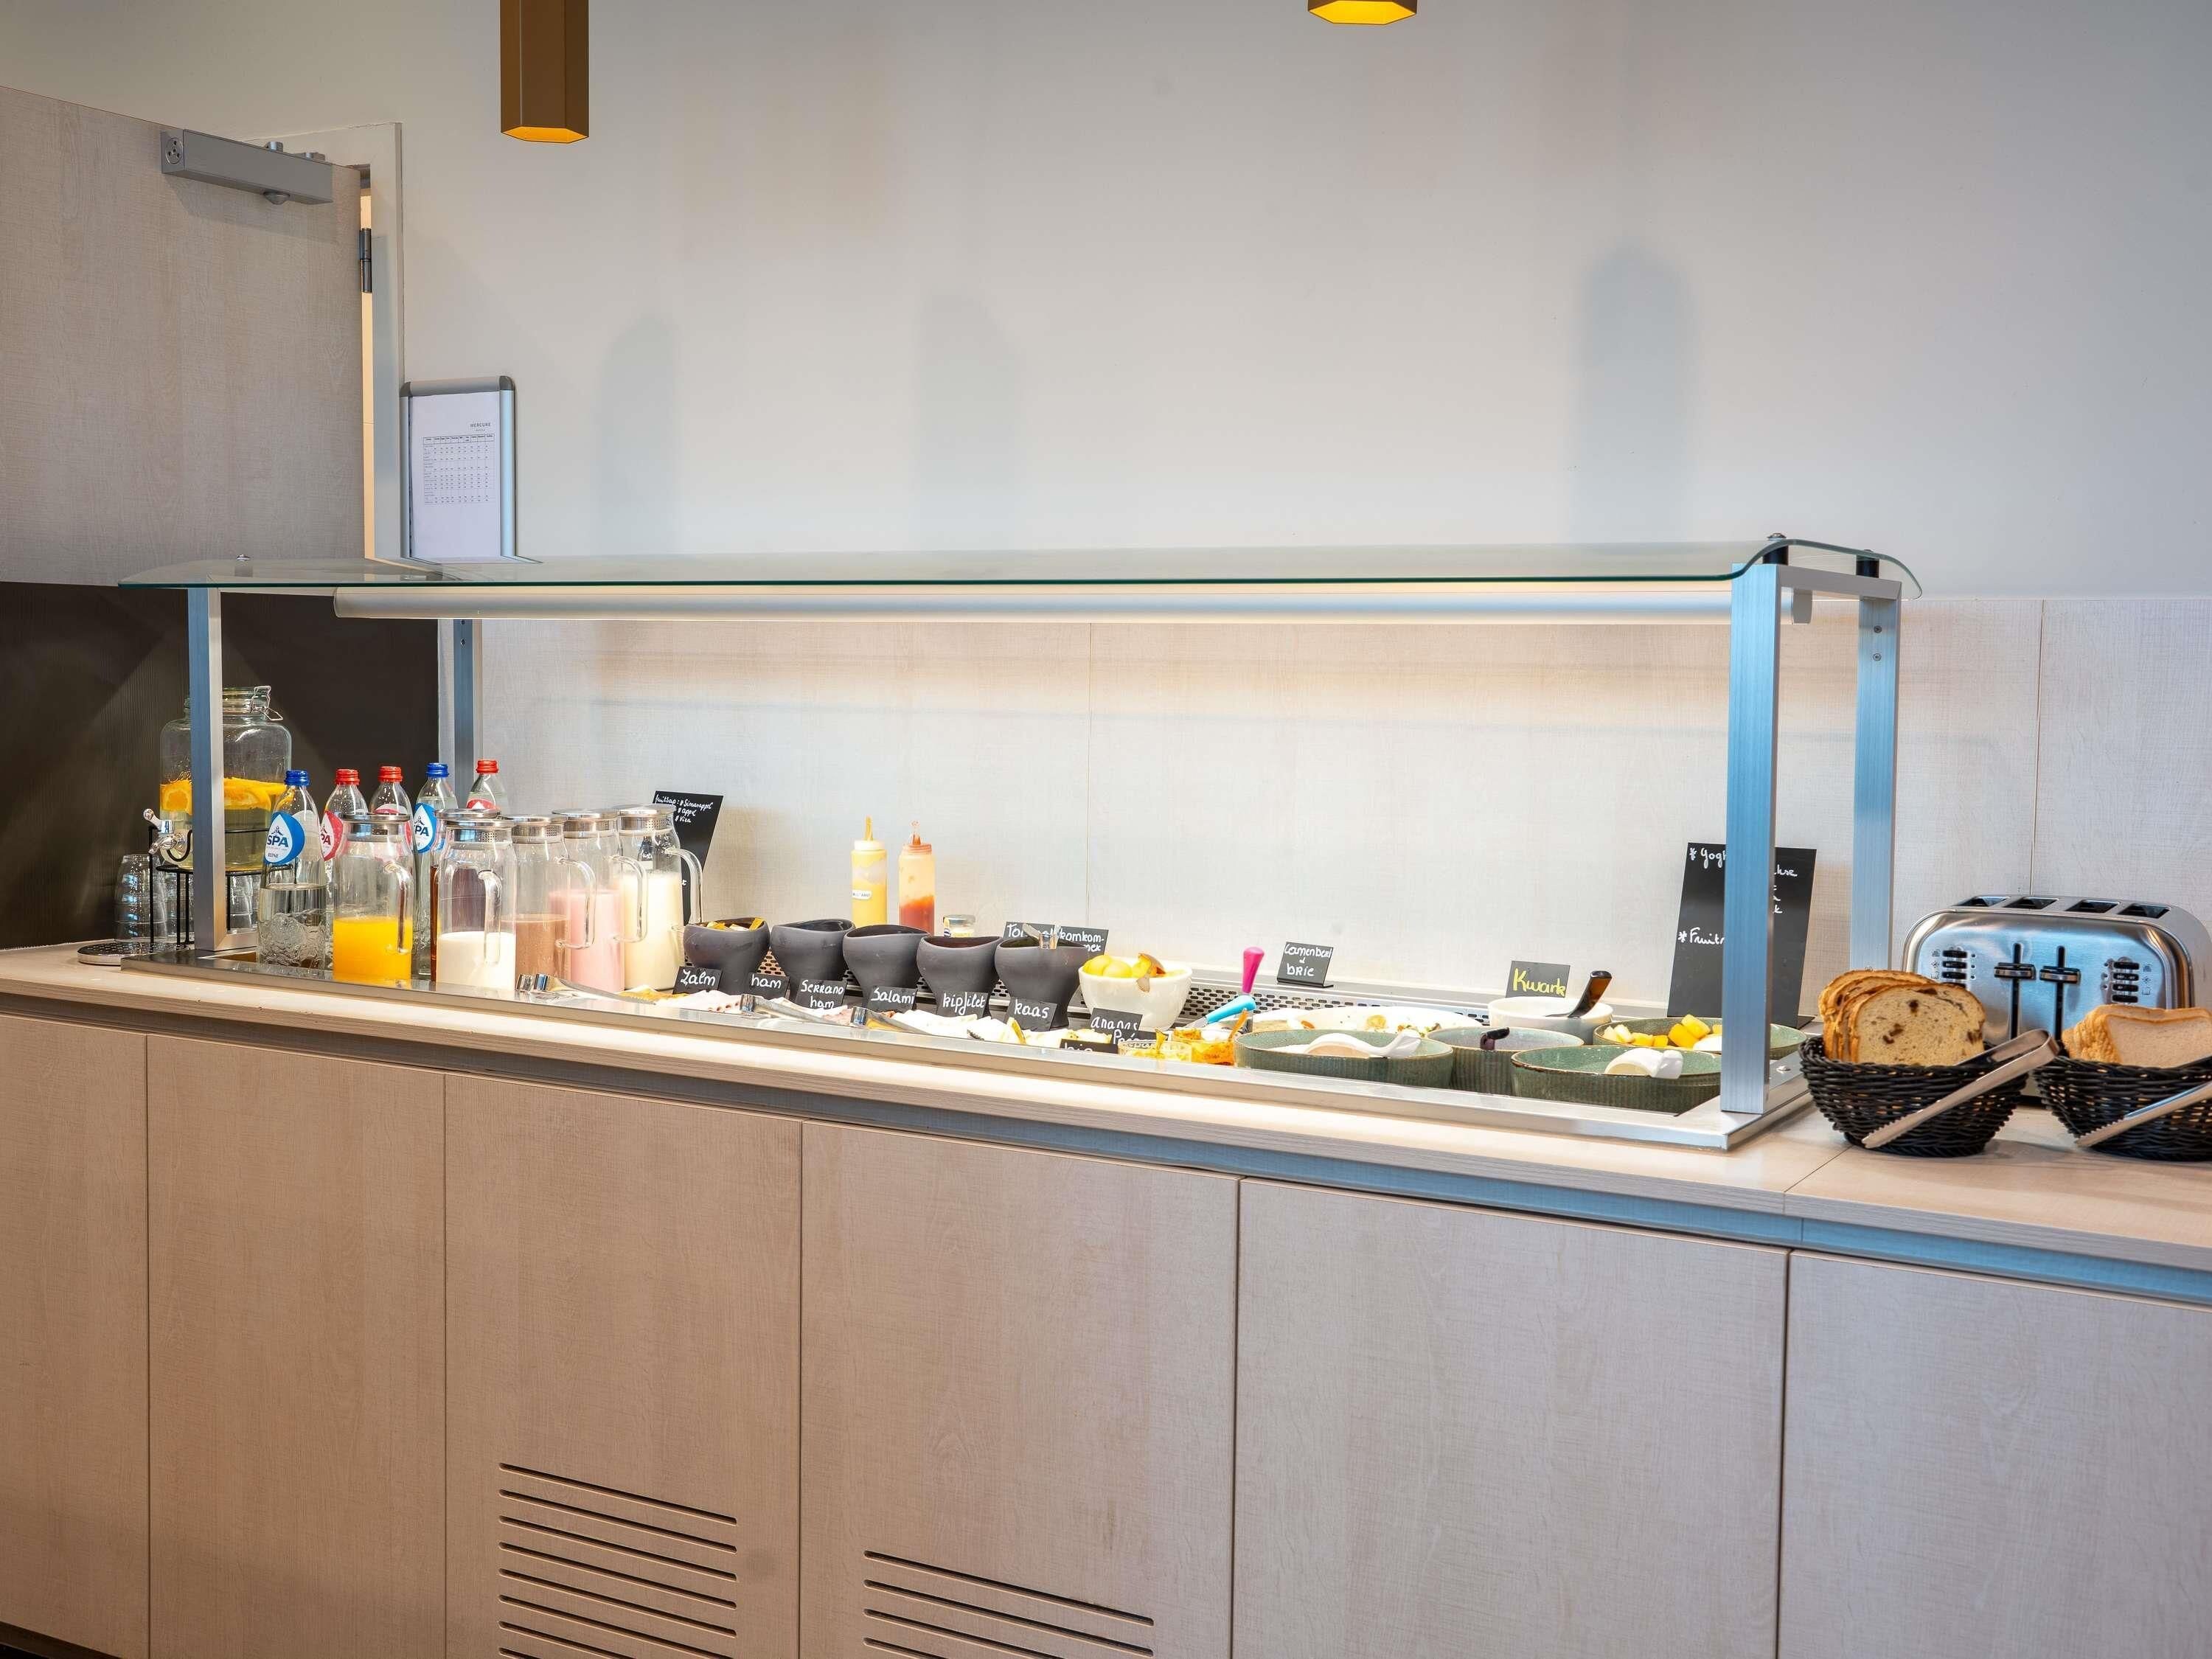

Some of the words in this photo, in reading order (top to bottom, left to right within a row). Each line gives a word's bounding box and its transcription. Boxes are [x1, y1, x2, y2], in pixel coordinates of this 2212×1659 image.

[414, 824, 429, 836] PA
[267, 835, 289, 848] SPA
[320, 833, 331, 845] PA
[751, 973, 782, 989] ham
[810, 995, 835, 1008] ham
[871, 987, 916, 1004] Salami
